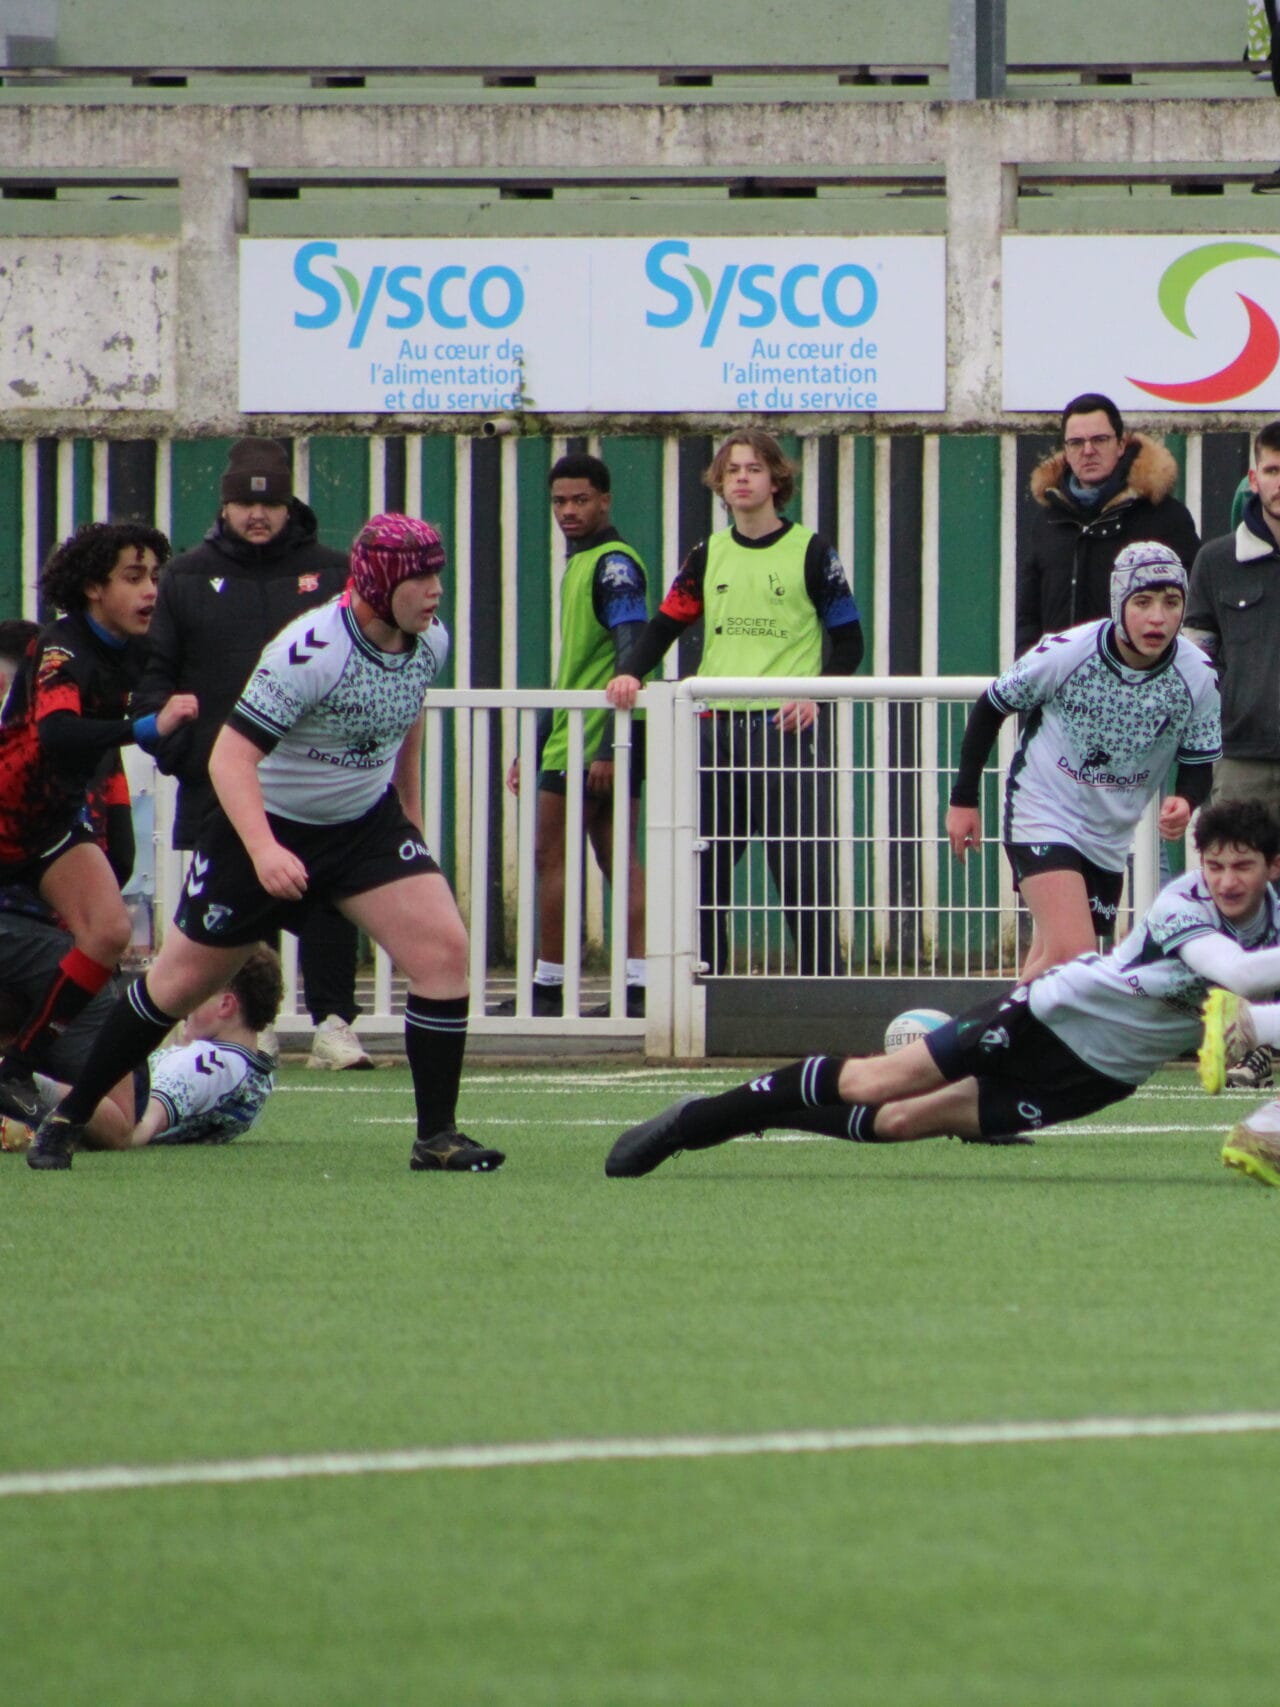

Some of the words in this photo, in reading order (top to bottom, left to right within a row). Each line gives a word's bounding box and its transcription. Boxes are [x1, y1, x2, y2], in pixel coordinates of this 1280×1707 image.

[293, 241, 524, 349] Sysco
[645, 240, 878, 348] Sysco
[398, 338, 427, 360] Au
[434, 343, 490, 360] cœur
[496, 338, 524, 360] de
[752, 337, 780, 360] Au
[787, 342, 844, 360] cœur
[850, 336, 878, 360] de
[370, 363, 523, 385] l'alimentation
[723, 362, 877, 384] l'alimentation
[384, 390, 406, 410] et
[412, 387, 440, 410] du
[447, 387, 524, 410] service
[737, 389, 758, 409] et
[764, 387, 793, 409] du
[801, 387, 878, 409] service
